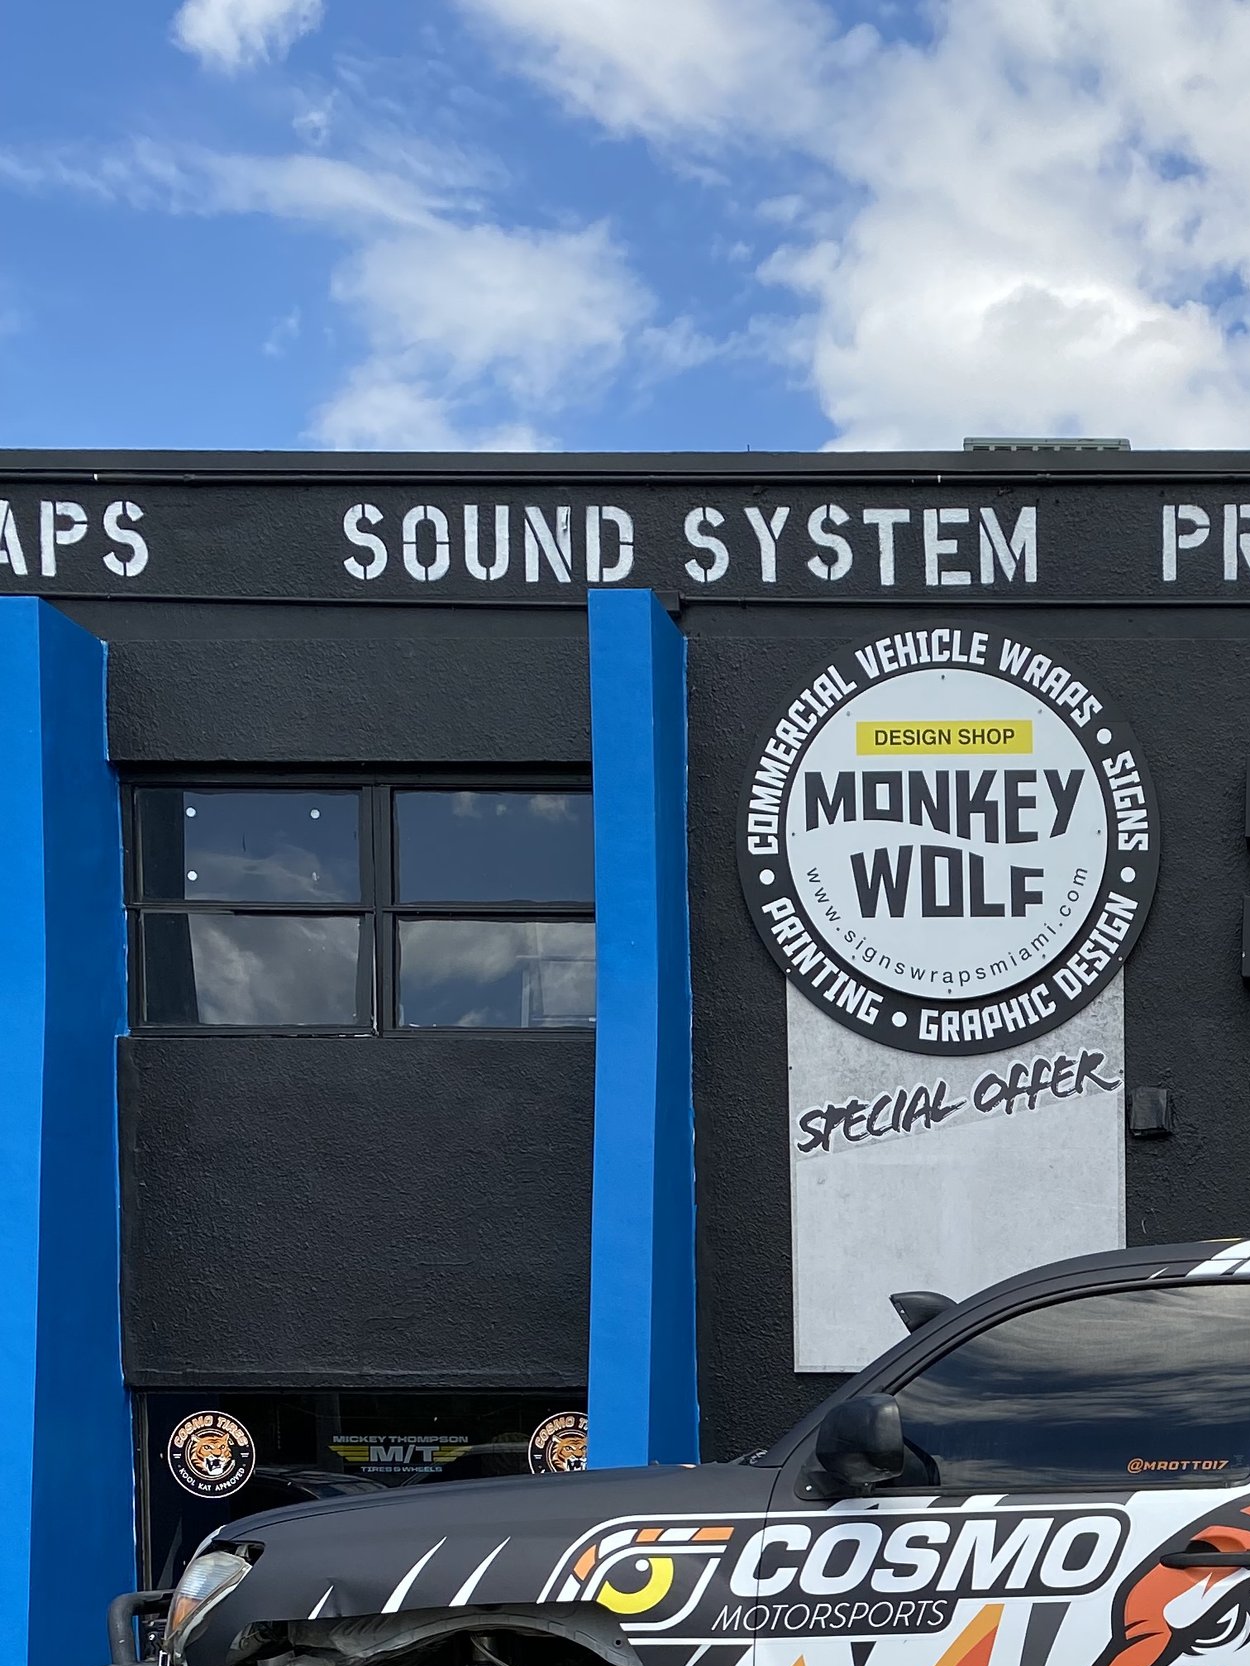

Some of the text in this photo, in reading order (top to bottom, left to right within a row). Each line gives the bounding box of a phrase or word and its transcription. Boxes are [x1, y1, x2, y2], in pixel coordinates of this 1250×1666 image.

[343, 503, 1038, 586] SOUND SYSTEM
[748, 628, 1103, 855] COMMERCIAL VEHICLE WRAPS
[874, 728, 1015, 746] DESIGN SHOP
[804, 768, 1086, 844] MONKEY
[1101, 750, 1149, 852] SIGNS
[849, 844, 1044, 918] WOLF
[762, 897, 884, 1025] PRINTING
[806, 865, 1089, 987] www.signswrapsmiami.com
[918, 891, 1139, 1042] GRAPHIC DESIGN
[797, 1050, 1123, 1153] SPECIAL OFFER
[174, 1415, 249, 1448] COSMO TIRES
[333, 1435, 468, 1443] MICKEY THOMPSON
[370, 1444, 440, 1463] M/T
[535, 1416, 575, 1449] COSMO
[179, 1467, 245, 1491] KOOL KAT APPROVED
[729, 1515, 1105, 1596] COSMO
[710, 1599, 949, 1633] MOTORSPORTS
